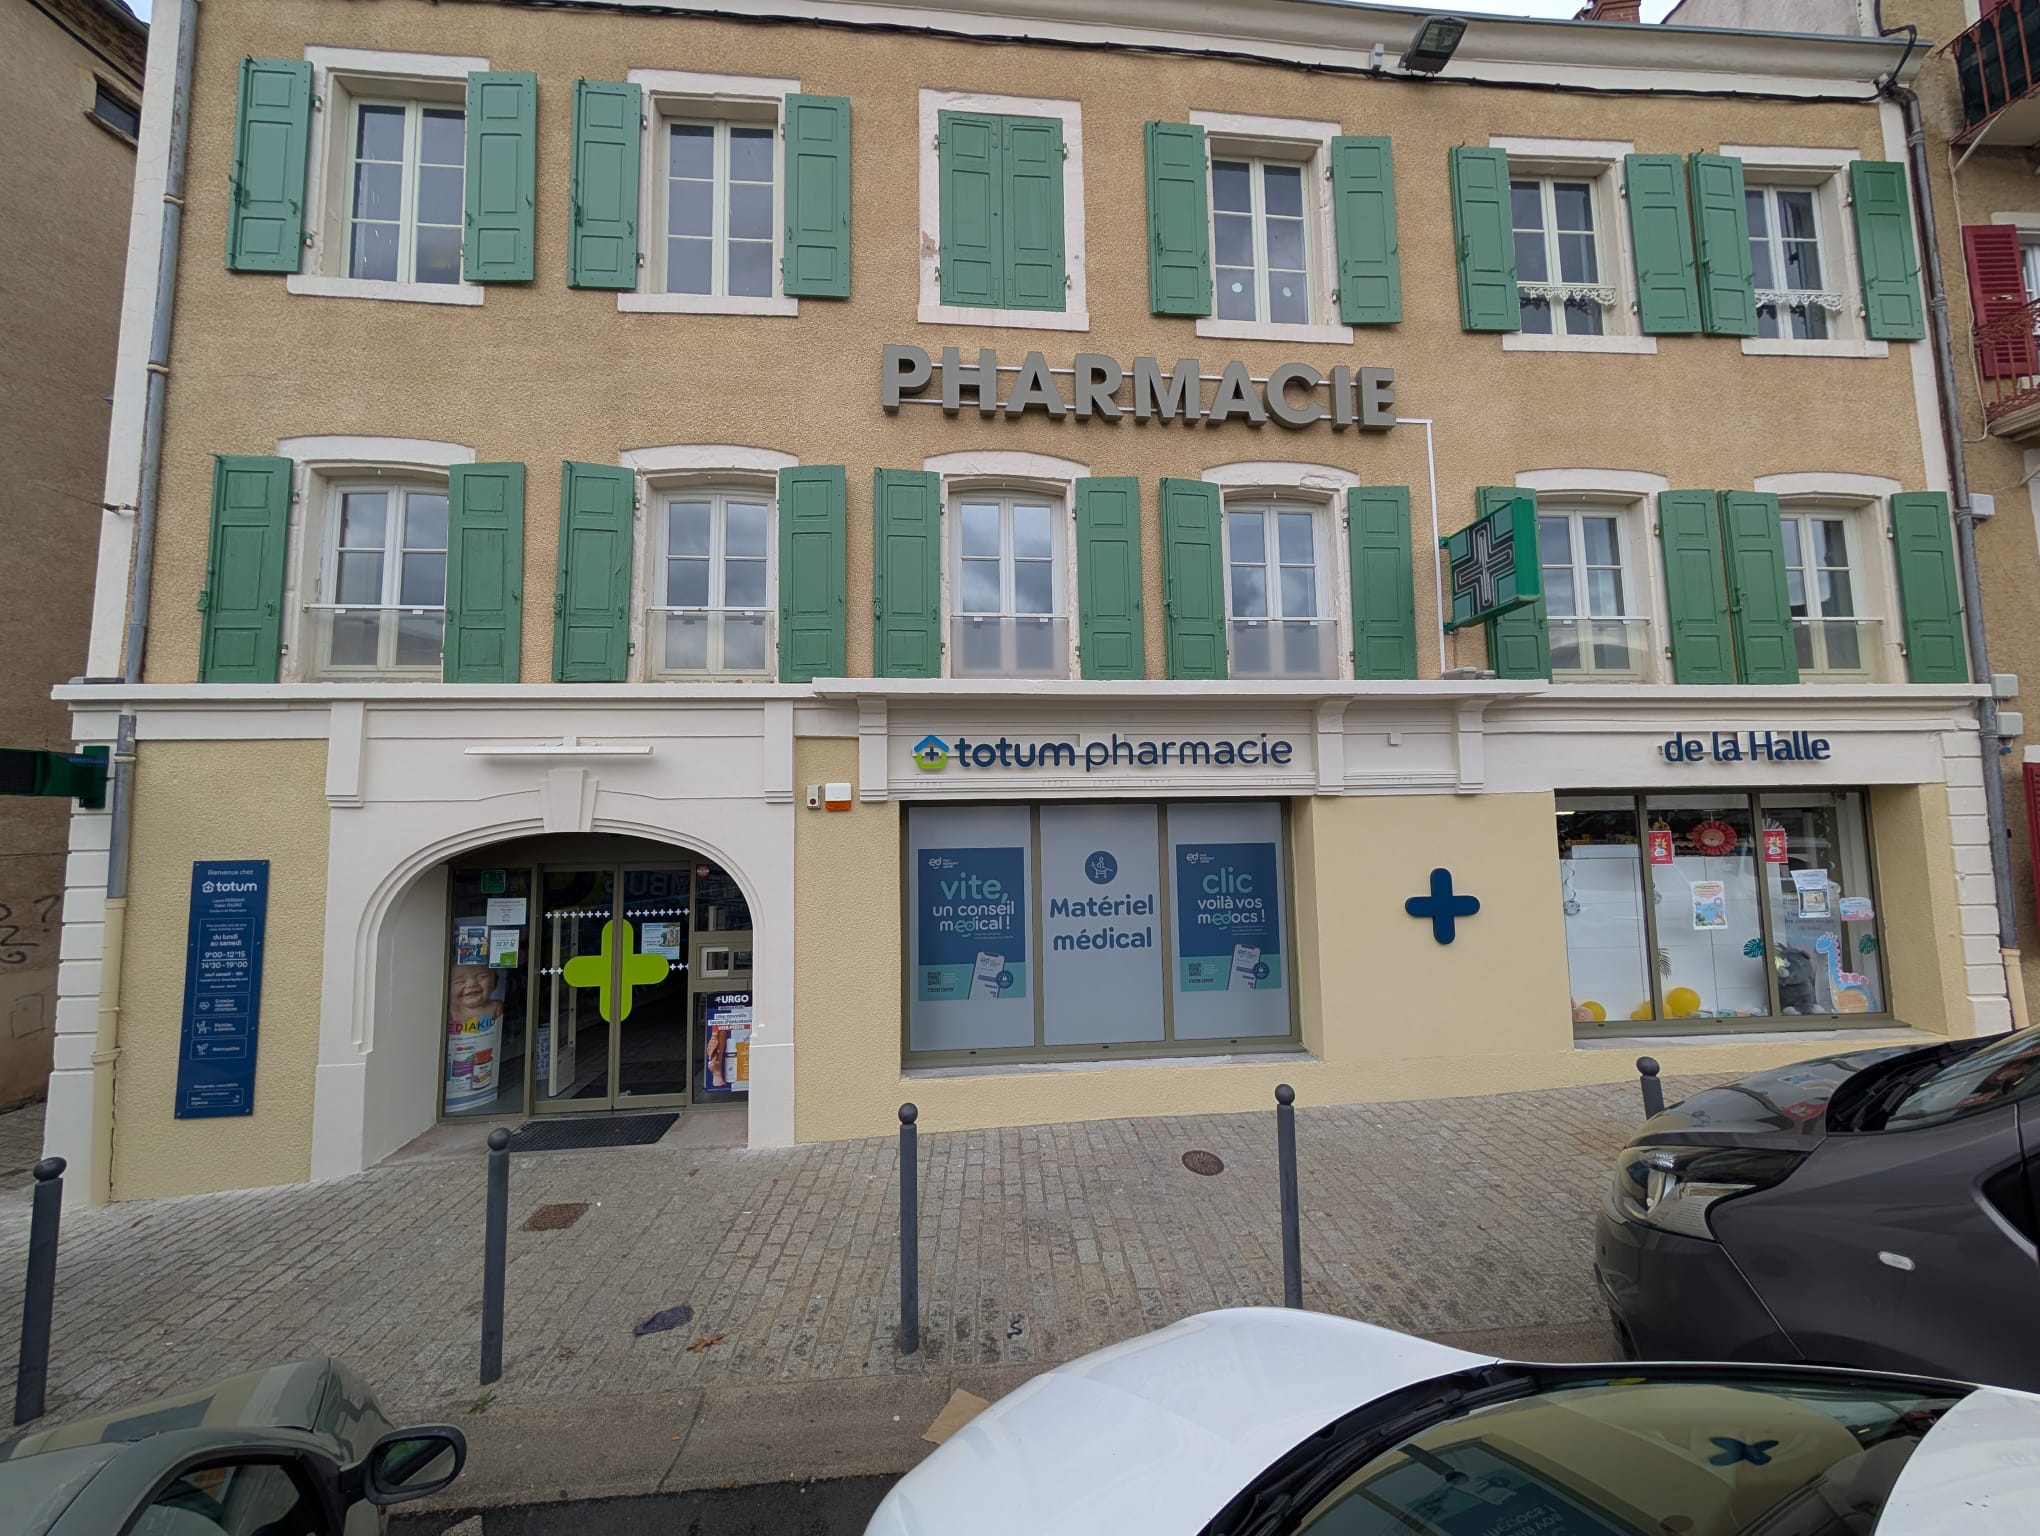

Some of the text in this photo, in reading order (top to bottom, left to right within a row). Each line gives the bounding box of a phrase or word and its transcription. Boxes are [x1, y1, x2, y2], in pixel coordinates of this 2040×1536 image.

[882, 344, 1398, 432] PHARMACIE
[953, 733, 1294, 772] totum pharmacie
[1664, 730, 1832, 762] de la Halle
[216, 881, 258, 892] totum
[940, 871, 1009, 904] vite,
[1202, 866, 1254, 894] clic
[932, 900, 1015, 917] un conseil
[1049, 893, 1154, 919] Matériel
[1197, 895, 1263, 910] voilà vos
[1053, 926, 1152, 951] médical
[721, 994, 750, 1004] URGO
